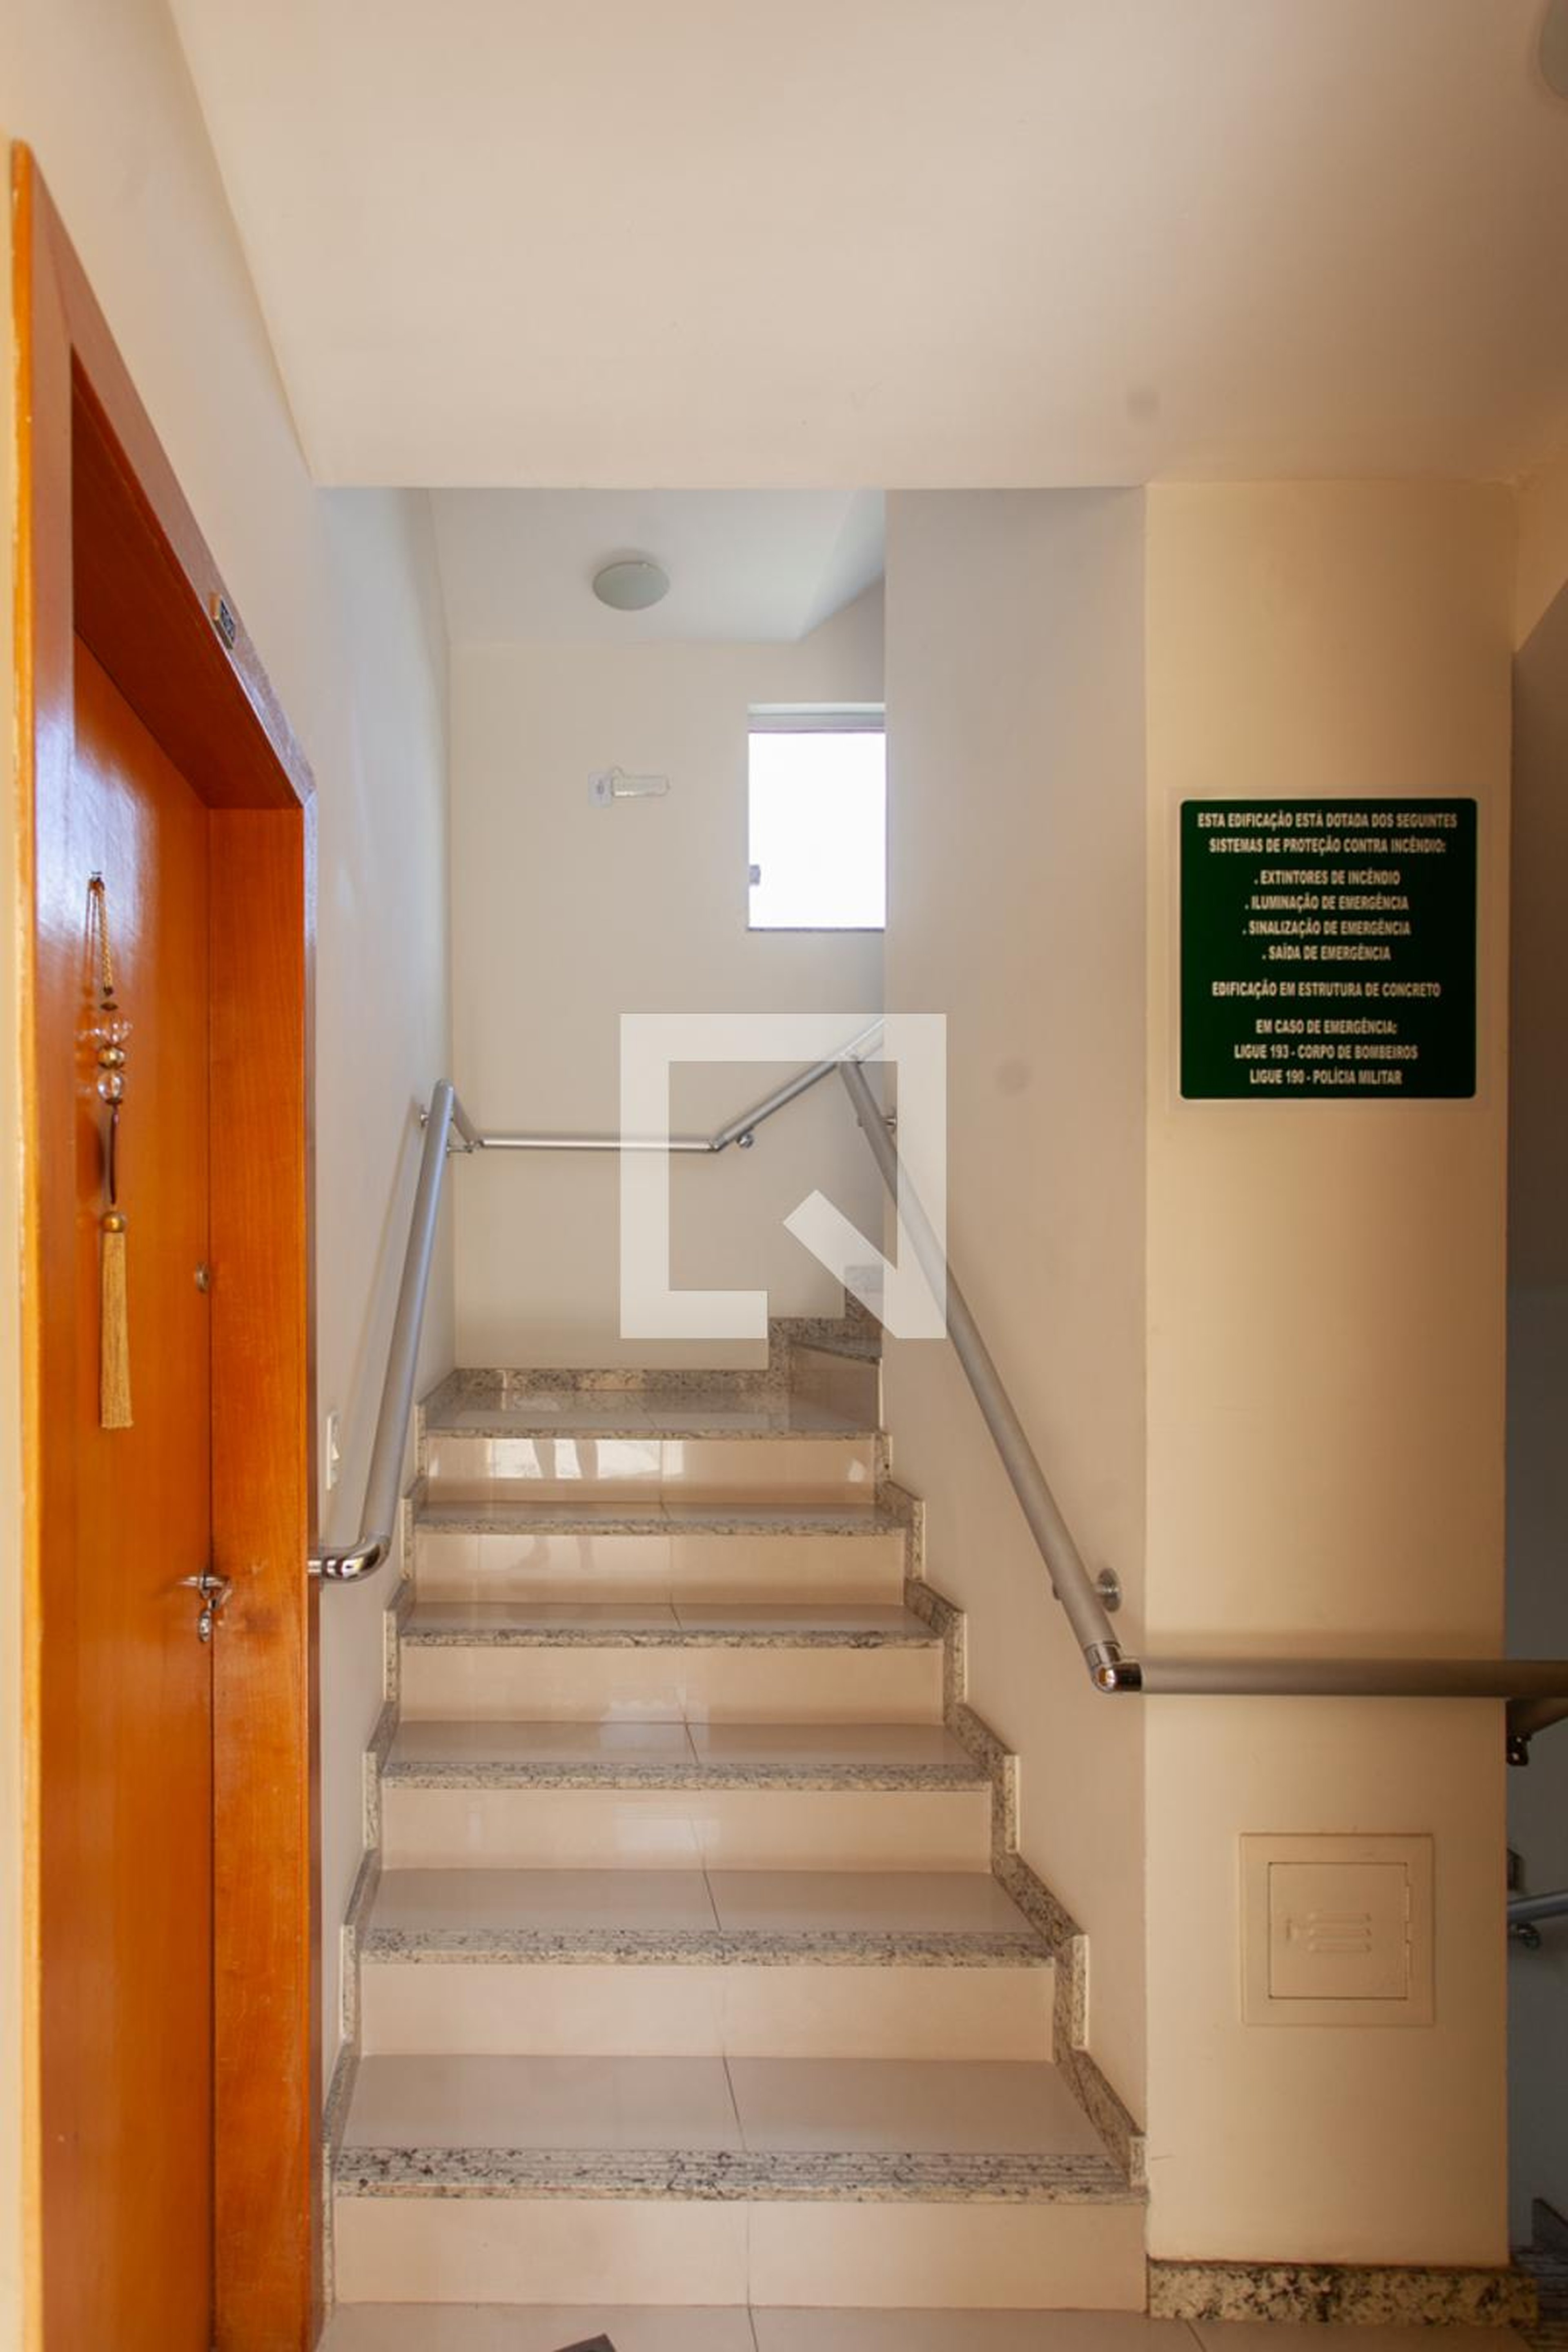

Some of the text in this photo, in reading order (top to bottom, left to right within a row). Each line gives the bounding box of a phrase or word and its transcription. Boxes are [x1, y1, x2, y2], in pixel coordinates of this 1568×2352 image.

[1197, 813, 1225, 828] ESTA
[1227, 810, 1293, 831] EDIFICAÇÃO
[1326, 813, 1369, 828] DOTADA
[1372, 813, 1394, 828] DOS
[1396, 813, 1457, 828] SEGUINTES
[1209, 837, 1263, 853] SISTEMAS
[1266, 837, 1281, 853] DE
[1283, 835, 1341, 856] PROTEÇÃO
[1343, 838, 1388, 853] CONTRA
[1260, 870, 1328, 885] EXTINTORES
[1331, 870, 1345, 885] DE
[1348, 868, 1400, 885] INCÊNDIO
[1251, 892, 1319, 913] ILUMINAÇÃO
[1321, 895, 1336, 910] DE
[1339, 893, 1409, 910] EMERGÊNCIA
[1249, 917, 1321, 939] SINALIZAÇÃO
[1323, 920, 1338, 935] DE
[1341, 919, 1410, 935] EMERGÊNCIA
[1268, 943, 1301, 960] SAÍDA
[1303, 945, 1318, 960] DE
[1321, 943, 1391, 960] EMERGÊNCIA
[1212, 978, 1441, 1000] EDIFICAÇÃO EM ESTRUTURA DE CONCRETO
[1256, 1019, 1272, 1034] EM
[1274, 1019, 1304, 1034] CASO
[1307, 1019, 1321, 1034] DE
[1234, 1044, 1267, 1059] LIGUE
[1270, 1044, 1289, 1059] 193
[1297, 1044, 1335, 1059] CORPO
[1337, 1045, 1352, 1059] DE
[1354, 1045, 1418, 1060] BOMBEIROS
[1250, 1069, 1283, 1084] LIGUE
[1285, 1069, 1305, 1084] 190
[1313, 1067, 1356, 1084] POLÍCIA
[1359, 1070, 1402, 1085] MILITAR
